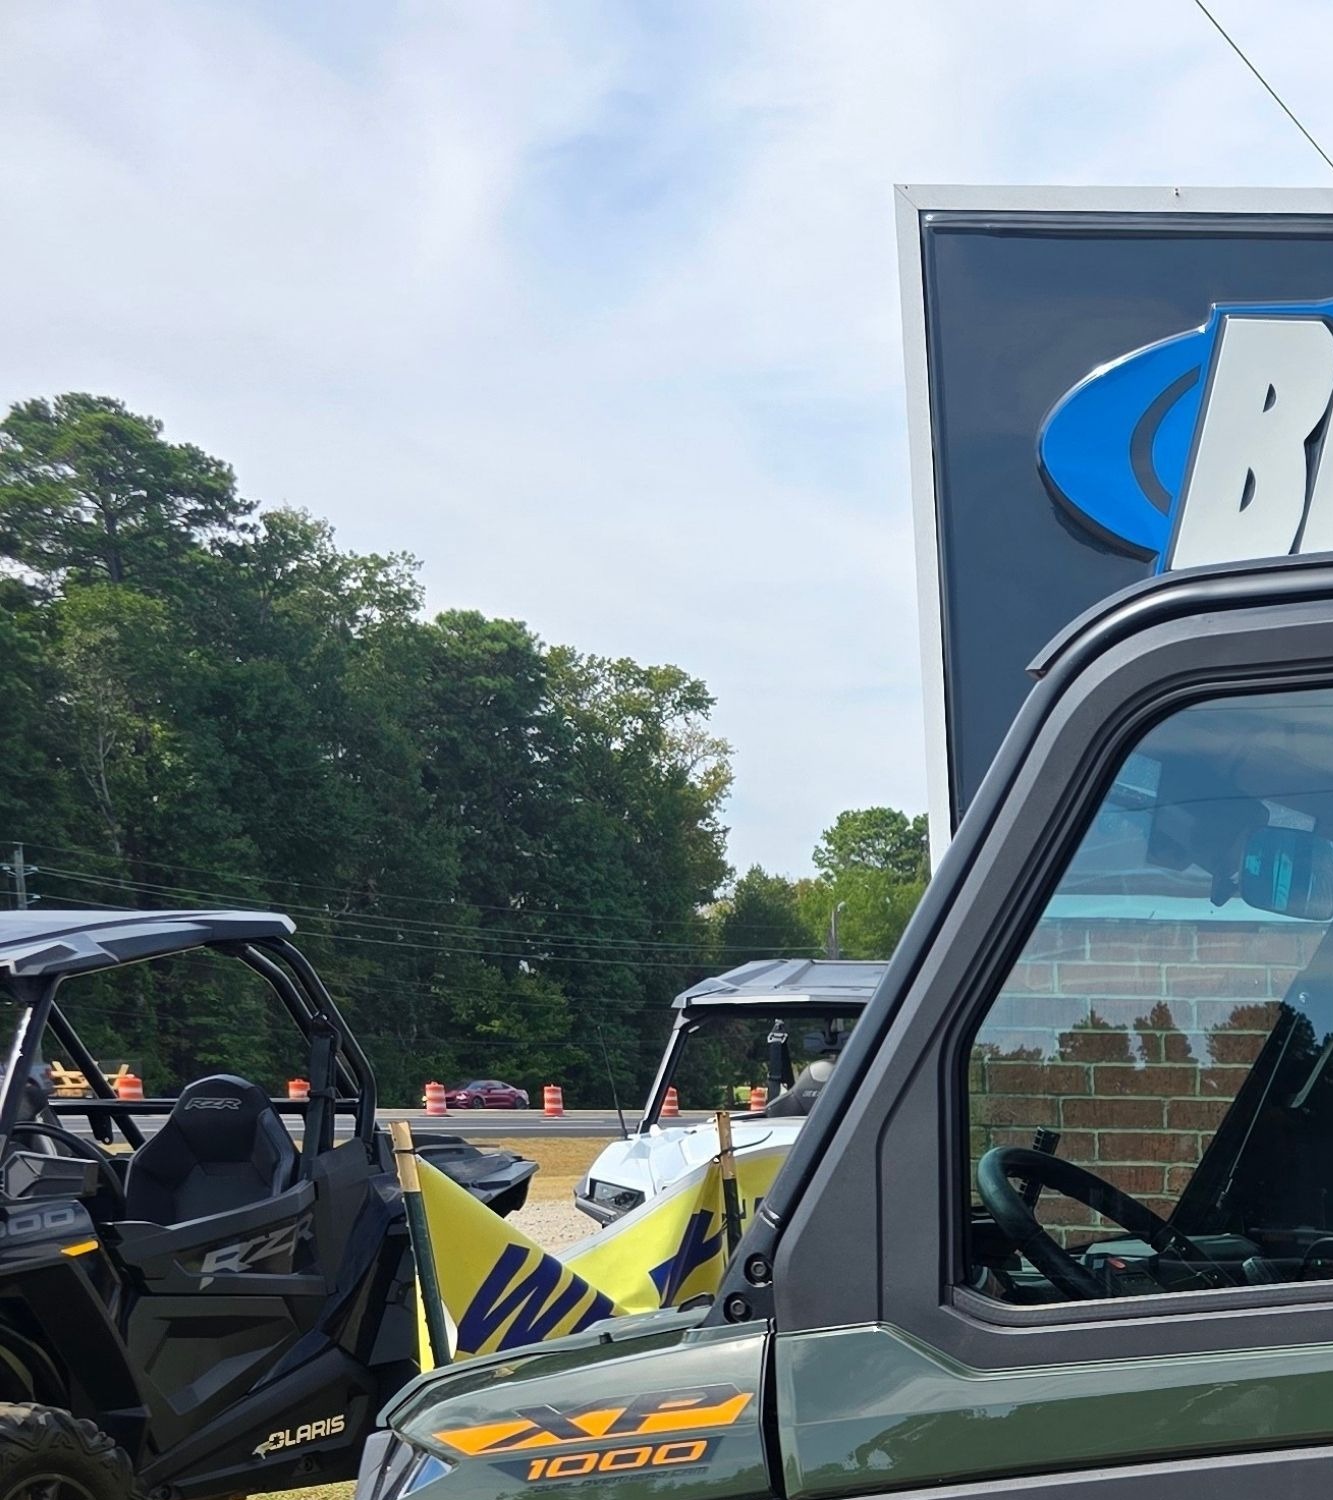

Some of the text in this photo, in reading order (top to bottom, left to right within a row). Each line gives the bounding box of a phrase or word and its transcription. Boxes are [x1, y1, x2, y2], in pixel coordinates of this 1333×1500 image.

[184, 1098, 242, 1110] RZR
[199, 1212, 315, 1291] RZR
[476, 1383, 744, 1452] XP
[527, 1440, 708, 1481] 1000
